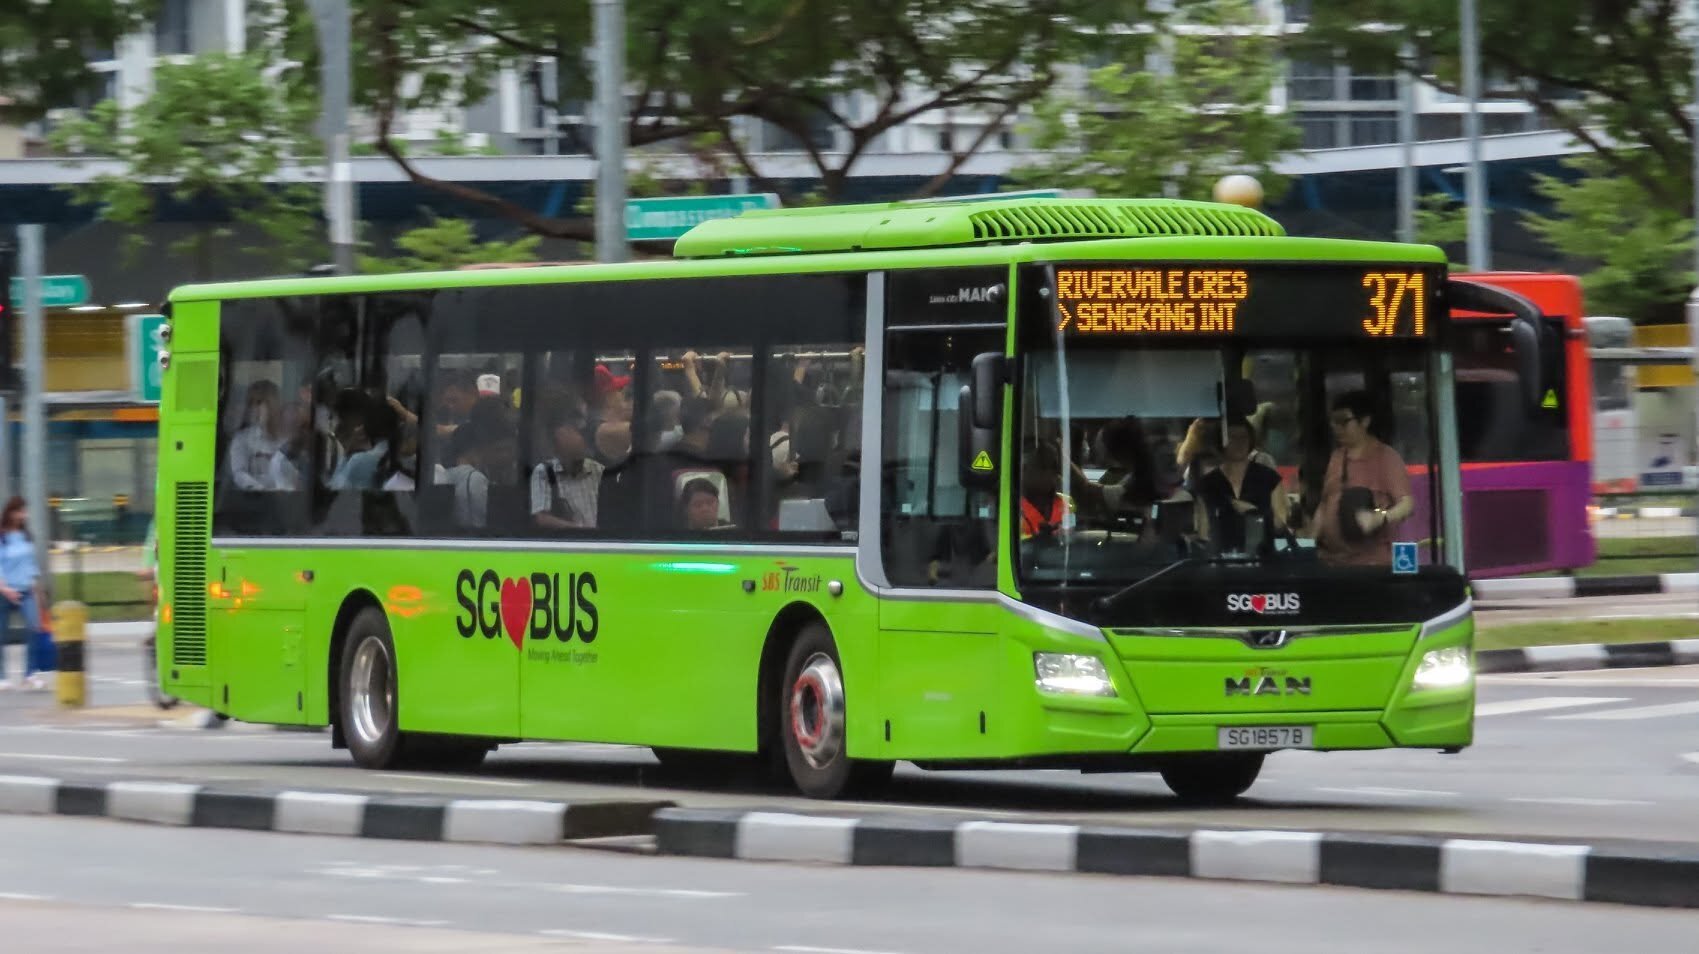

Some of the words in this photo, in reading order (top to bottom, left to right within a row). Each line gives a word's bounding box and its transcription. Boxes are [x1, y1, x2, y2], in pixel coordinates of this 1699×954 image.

[1057, 271, 1184, 299] RIVERVALE
[1188, 271, 1249, 299] CRES
[1076, 303, 1195, 331] SENGKANG
[1200, 303, 1236, 331] INT
[1362, 273, 1424, 335] 371
[781, 566, 822, 593] Transit
[1225, 676, 1311, 696] MAN
[1228, 728, 1303, 746] SG1857B
